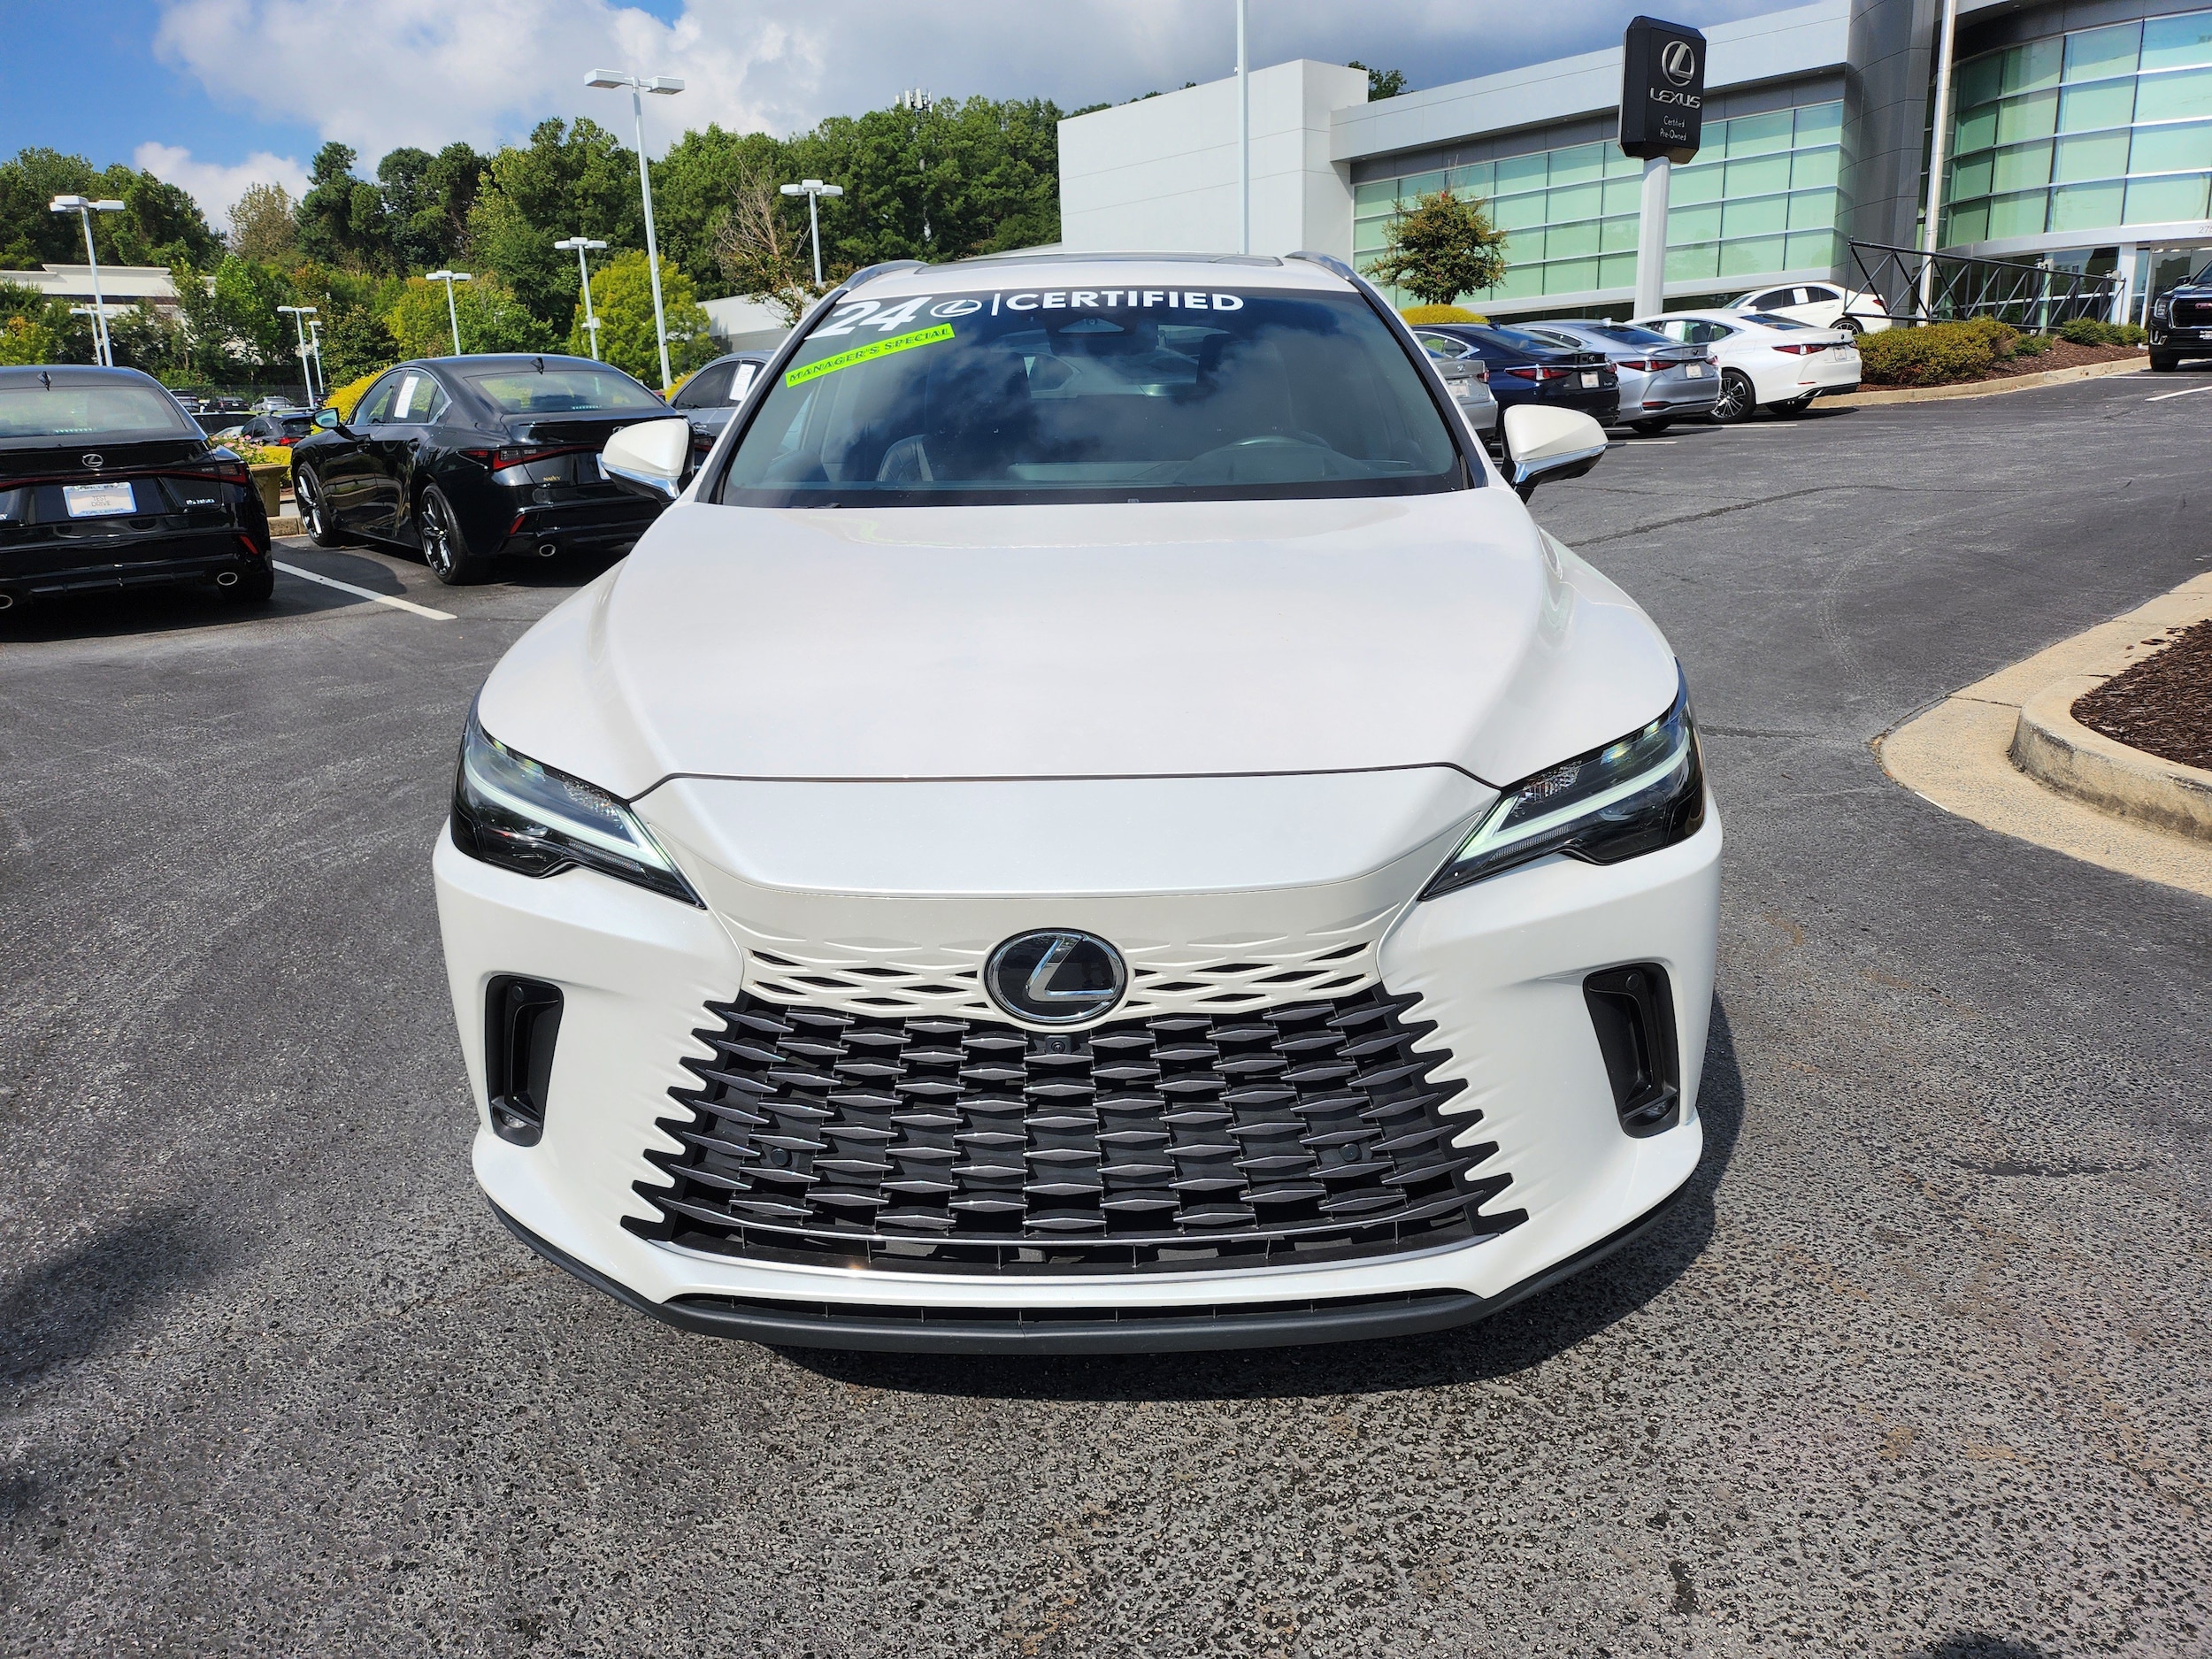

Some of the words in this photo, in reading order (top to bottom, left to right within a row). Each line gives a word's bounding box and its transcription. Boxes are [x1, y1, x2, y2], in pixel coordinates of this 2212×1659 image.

[1650, 88, 1701, 109] LEXUS
[1663, 115, 1686, 128] Certified
[1659, 128, 1687, 142] Pre-Owned
[804, 296, 933, 340] 24
[1006, 290, 1245, 311] CERTIFIED
[789, 345, 879, 383] MANAGER'S
[884, 326, 951, 351] SPECIAL
